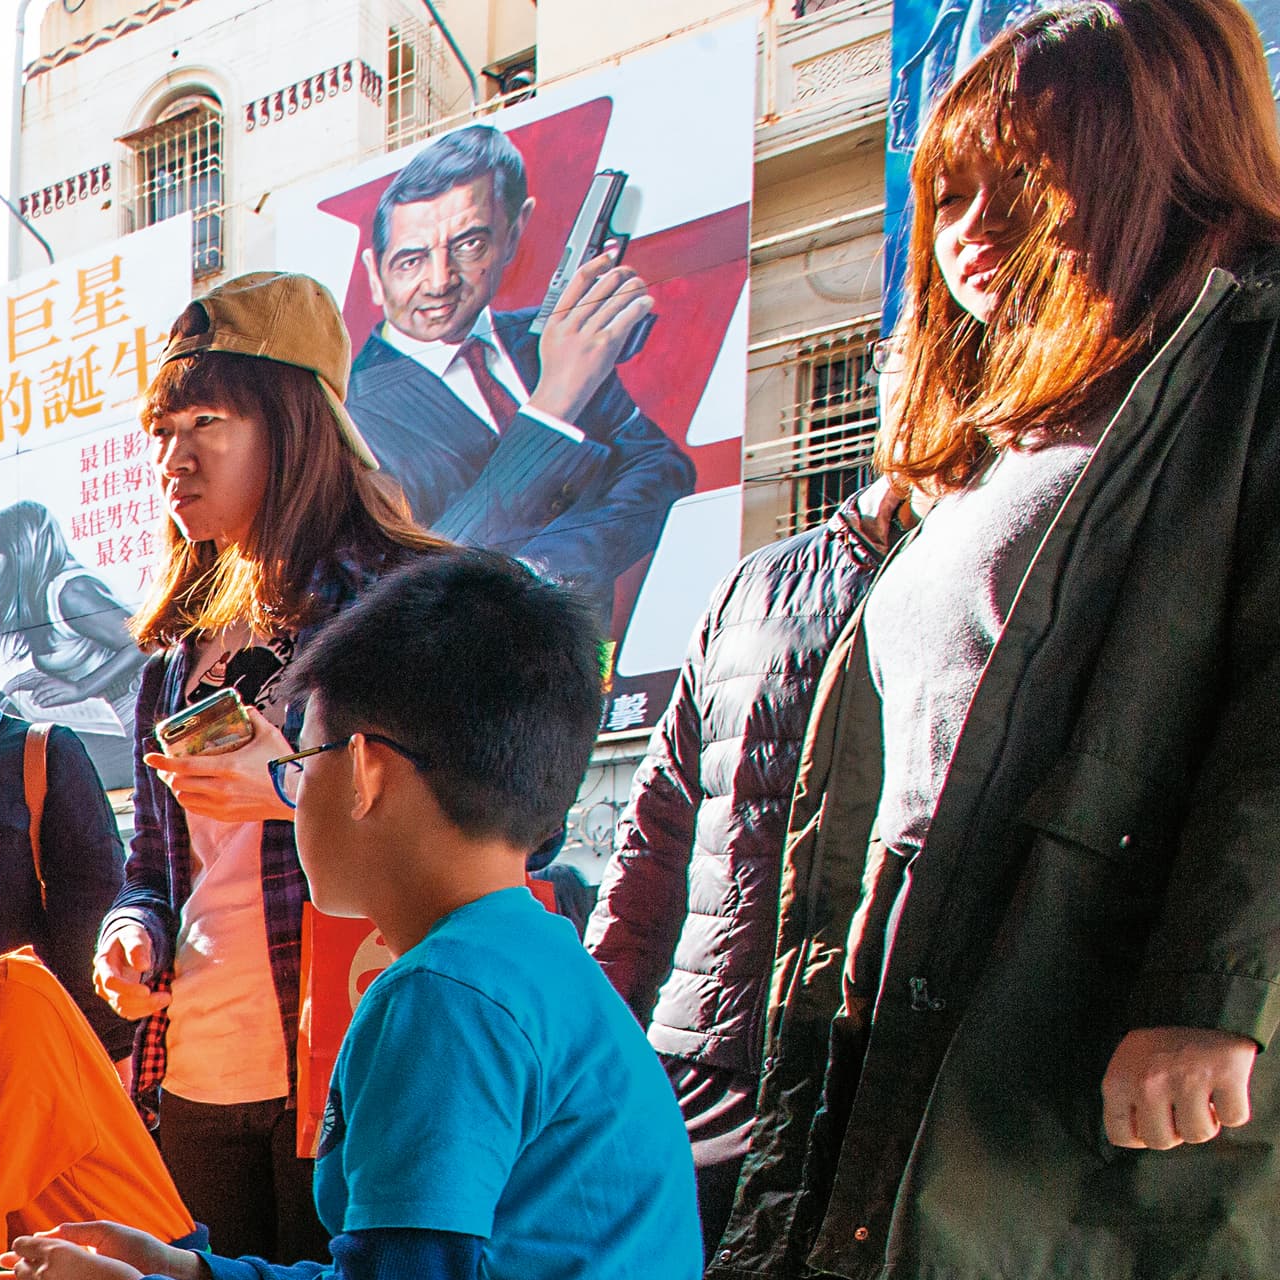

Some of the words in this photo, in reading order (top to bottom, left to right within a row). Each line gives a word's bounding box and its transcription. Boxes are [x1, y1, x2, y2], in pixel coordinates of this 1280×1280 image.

[80, 430, 151, 473] 最佳影
[96, 529, 161, 567] 最多金
